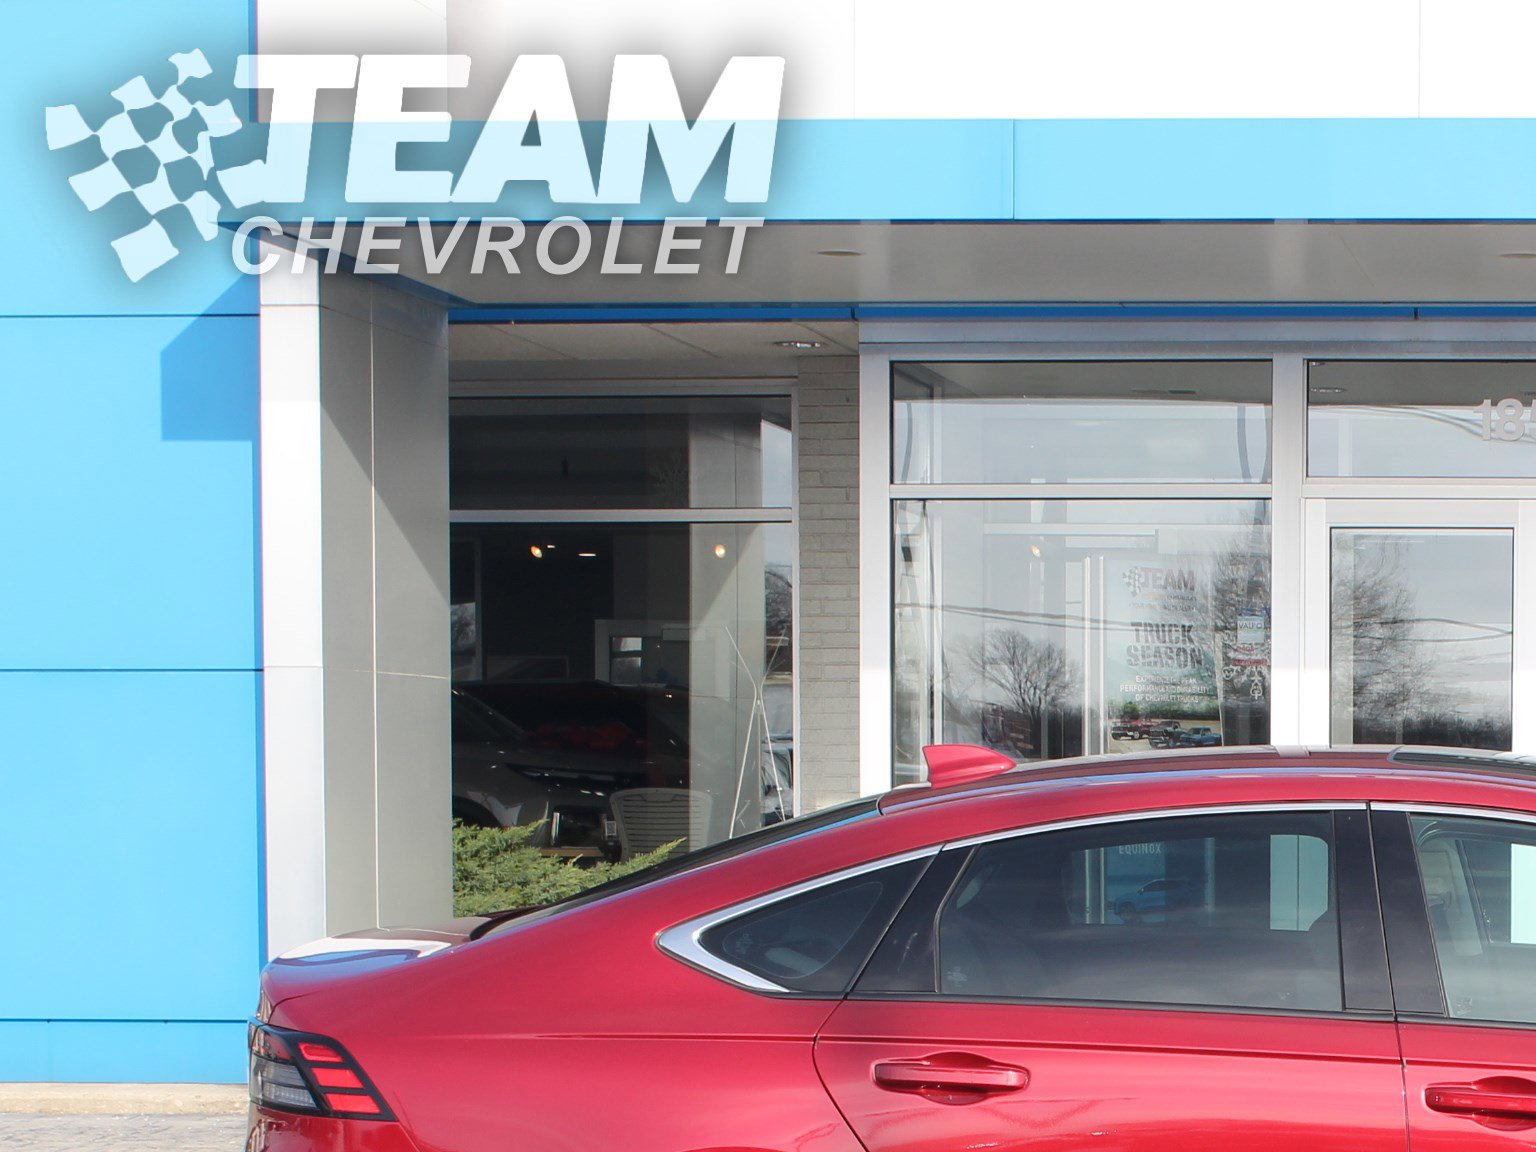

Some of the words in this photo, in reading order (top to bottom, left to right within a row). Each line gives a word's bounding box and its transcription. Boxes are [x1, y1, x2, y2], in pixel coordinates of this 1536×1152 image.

[1140, 567, 1195, 591] TEAM
[1130, 621, 1193, 645] TRUCK
[1126, 645, 1203, 669] SEASON
[1118, 843, 1161, 855] EQUINOX
